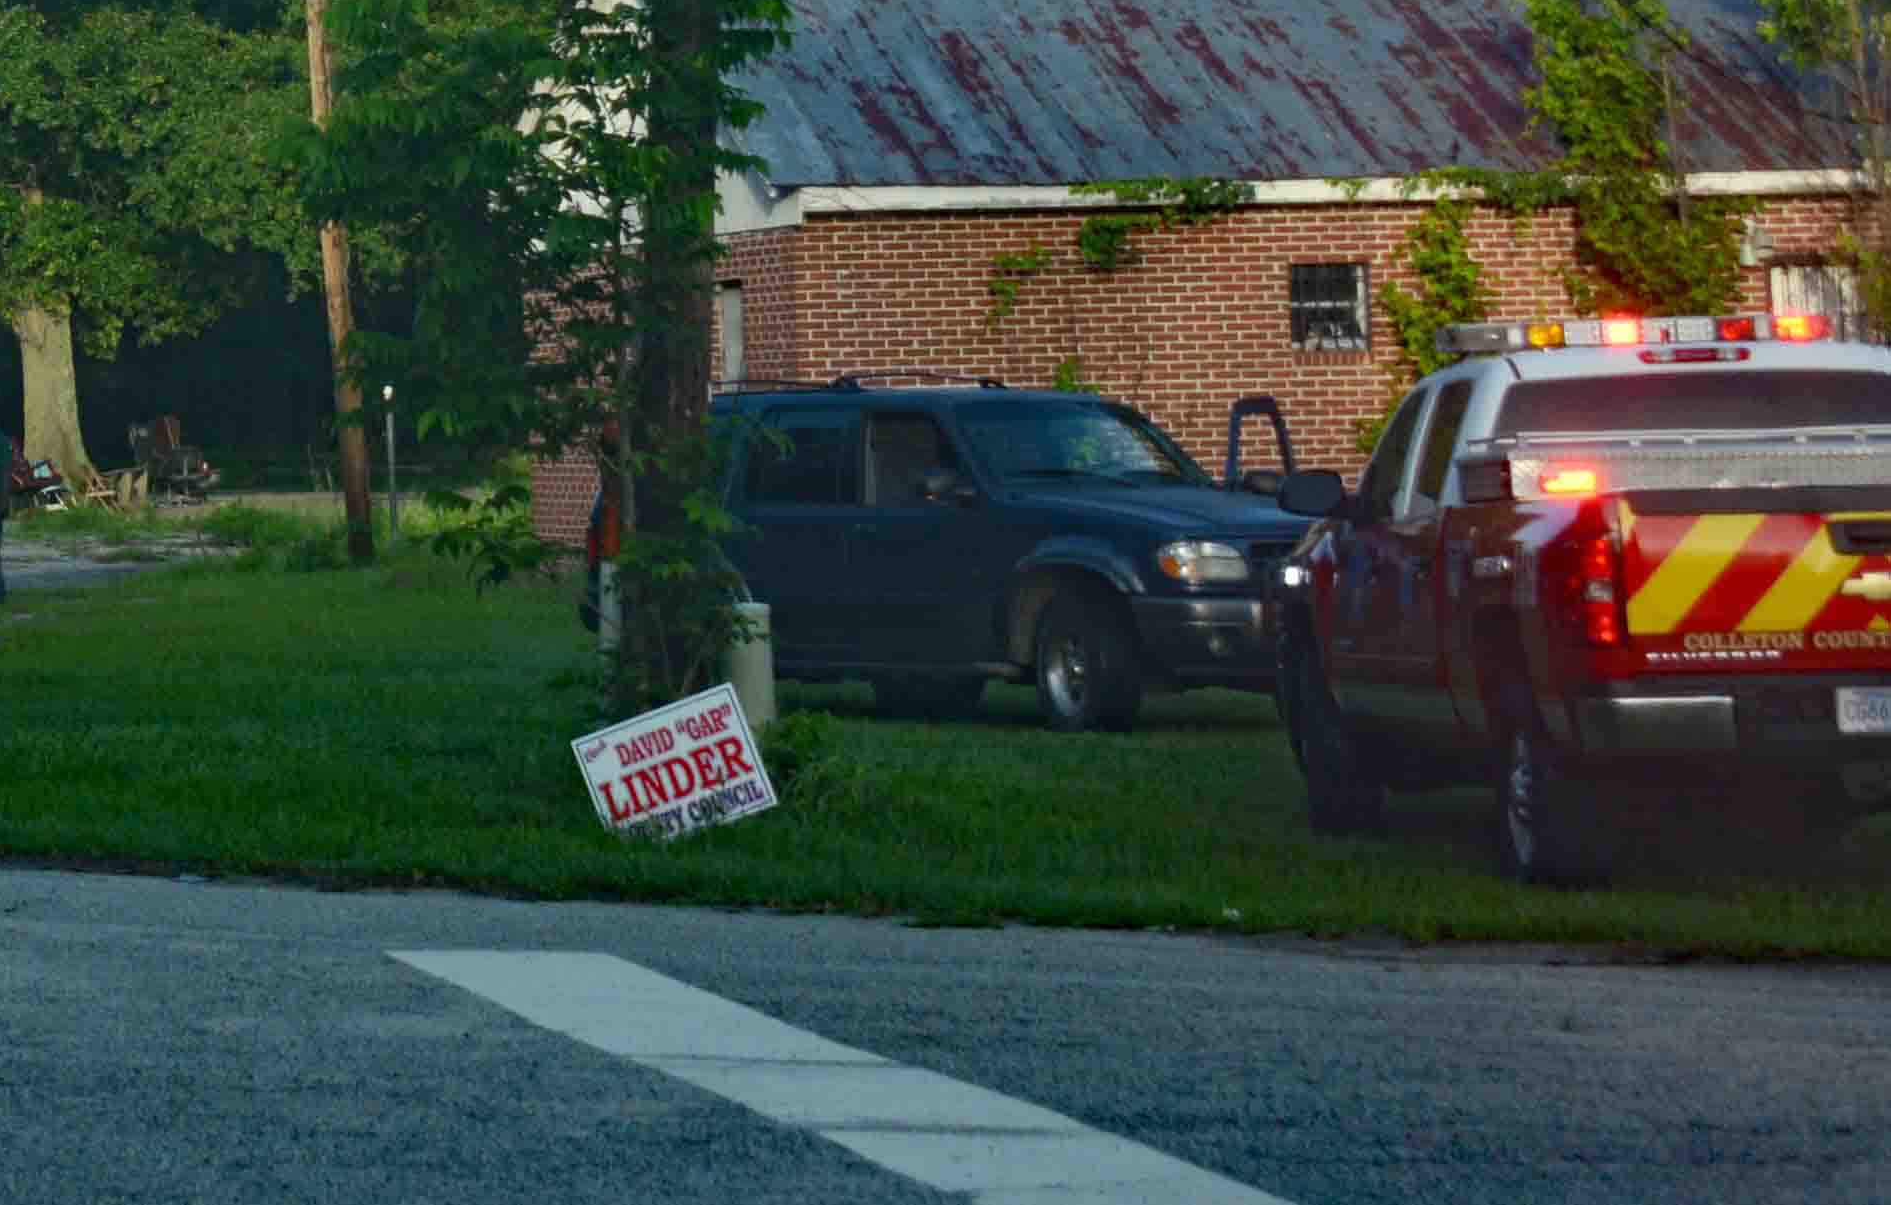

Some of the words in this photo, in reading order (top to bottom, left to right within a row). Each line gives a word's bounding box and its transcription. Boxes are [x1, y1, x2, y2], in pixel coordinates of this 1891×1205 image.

[1684, 632, 1805, 651] COLLETON
[615, 726, 675, 767] DAVID
[598, 735, 754, 822] LINDER
